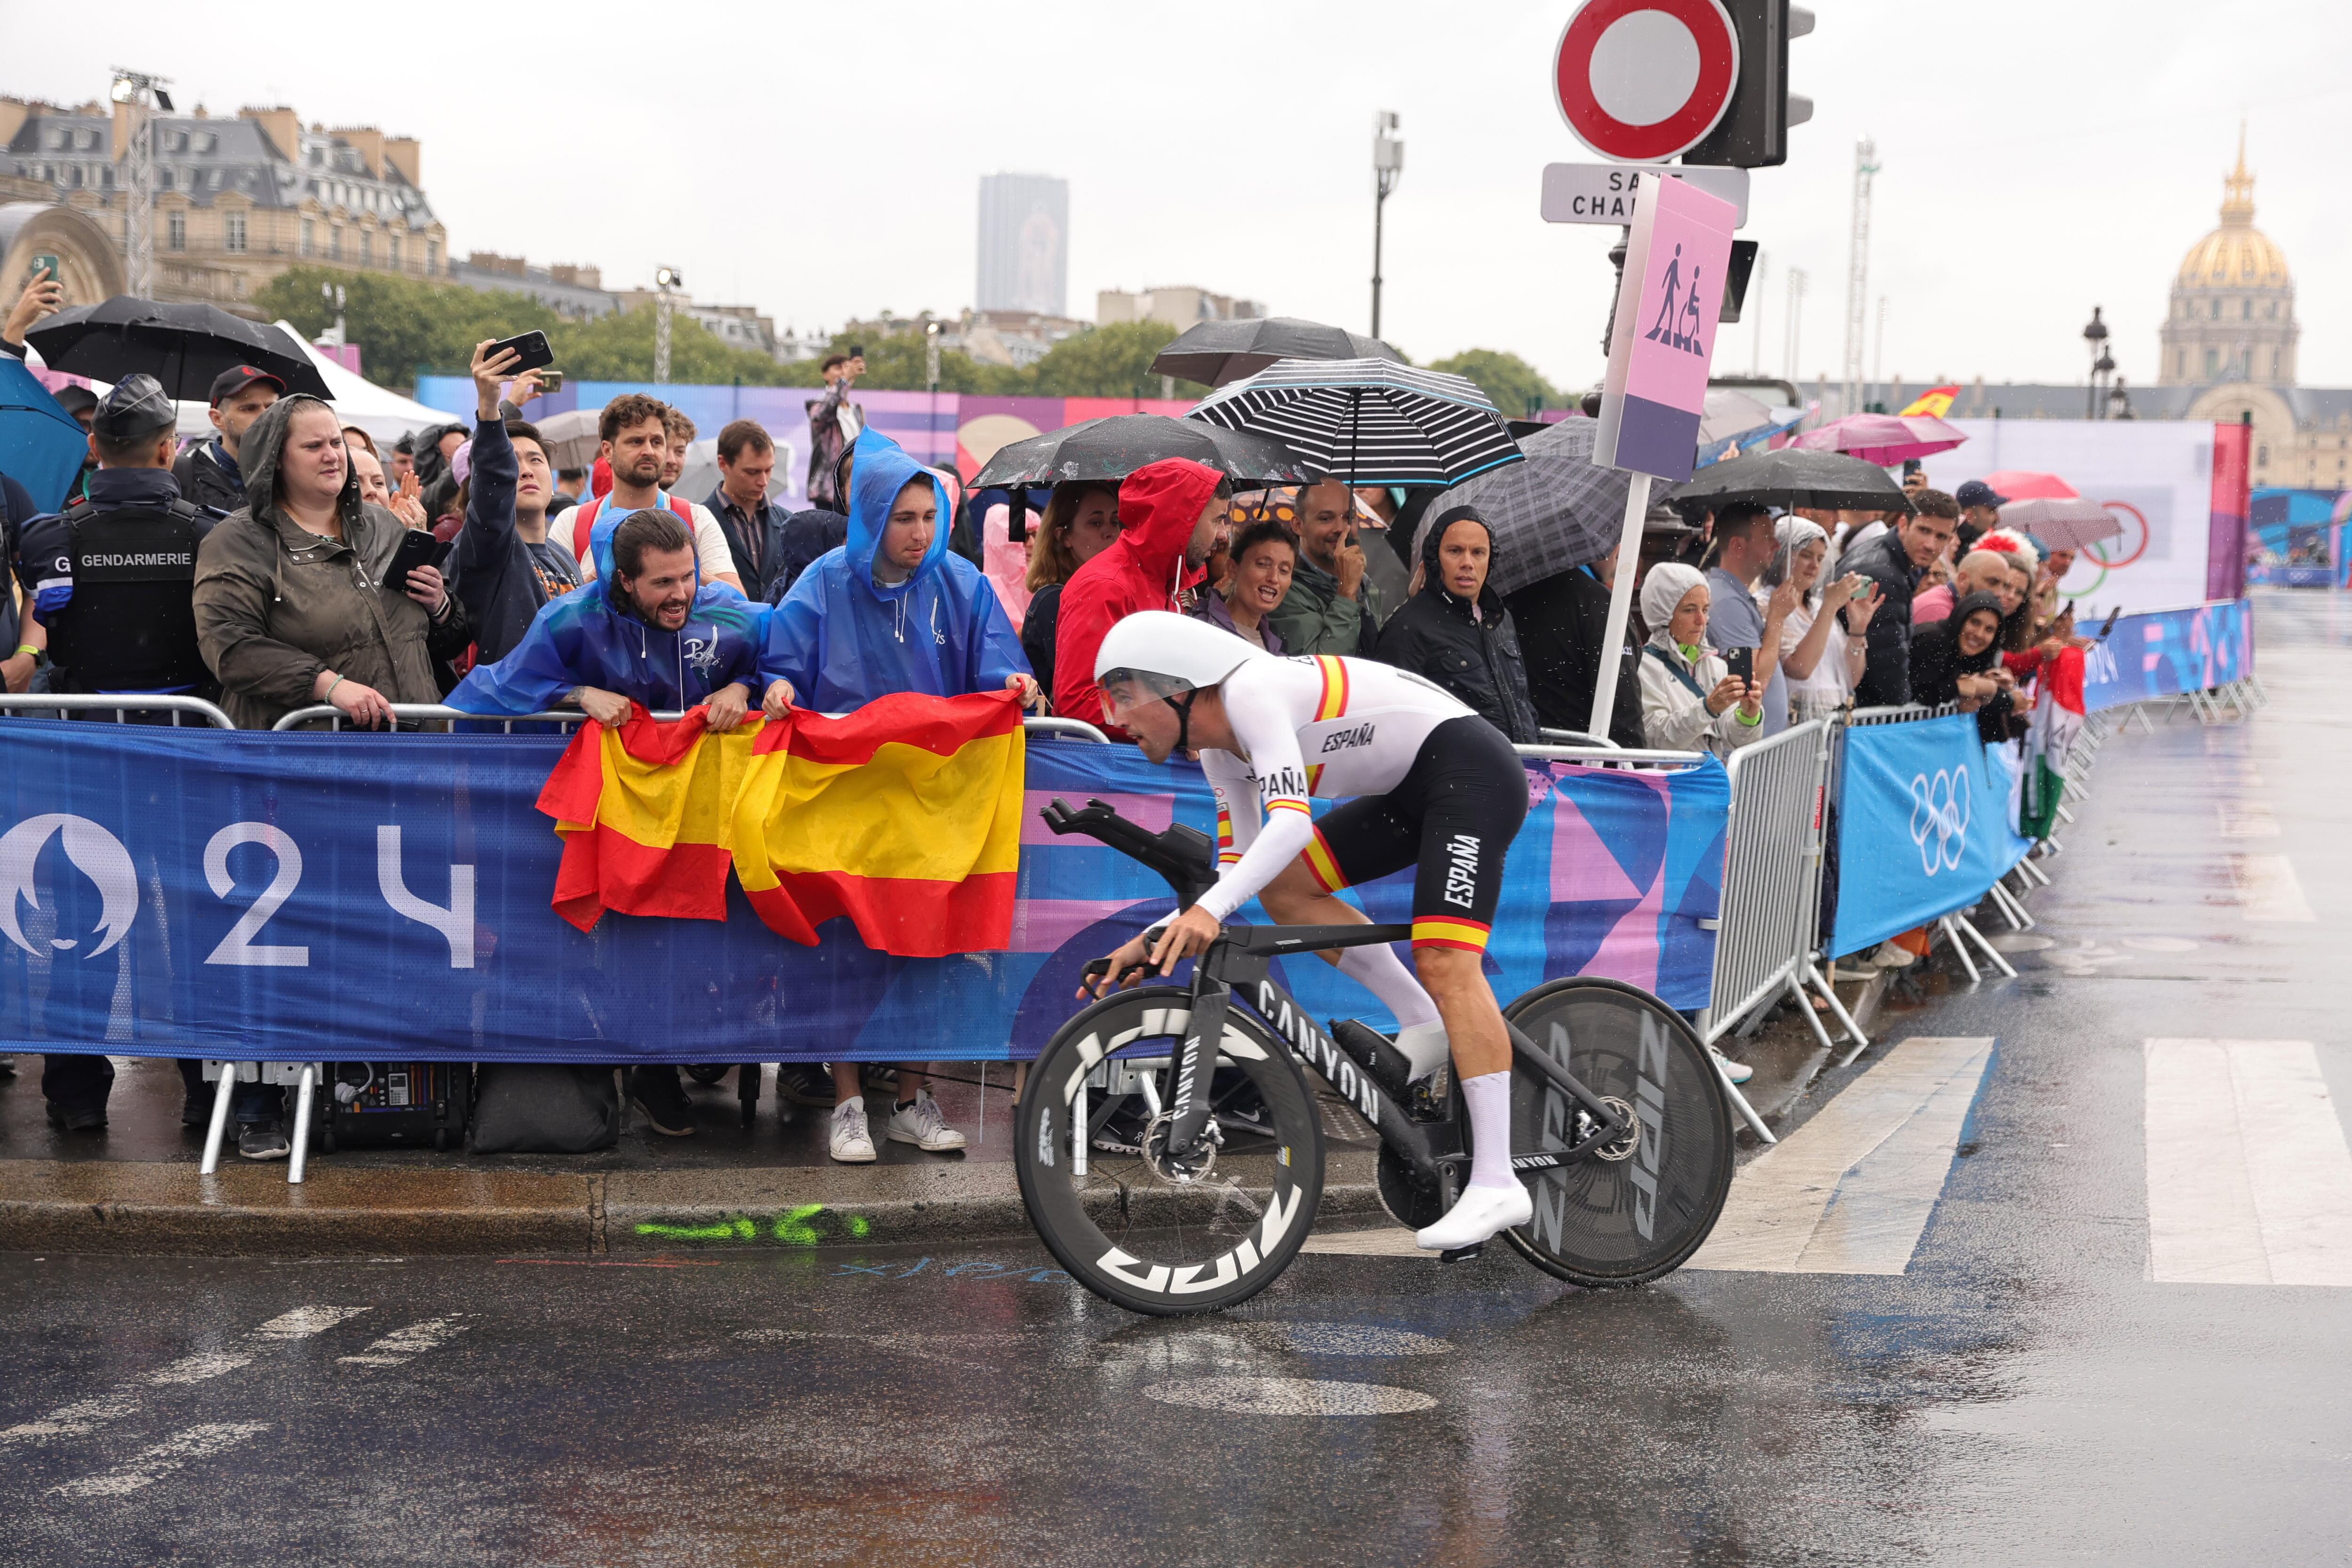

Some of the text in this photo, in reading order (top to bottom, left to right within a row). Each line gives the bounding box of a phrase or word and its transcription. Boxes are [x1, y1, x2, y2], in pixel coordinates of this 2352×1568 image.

[1572, 195, 1637, 216] CHA
[81, 553, 191, 567] GENDARMERIE
[1321, 722, 1376, 753] ESPAÑA
[1444, 834, 1481, 909] ESPAÑA
[1172, 1035, 1201, 1121] CANYON
[1258, 979, 1379, 1125] CANYON
[1630, 1009, 1670, 1241] ZIPP
[1096, 1183, 1303, 1294] ZIPP
